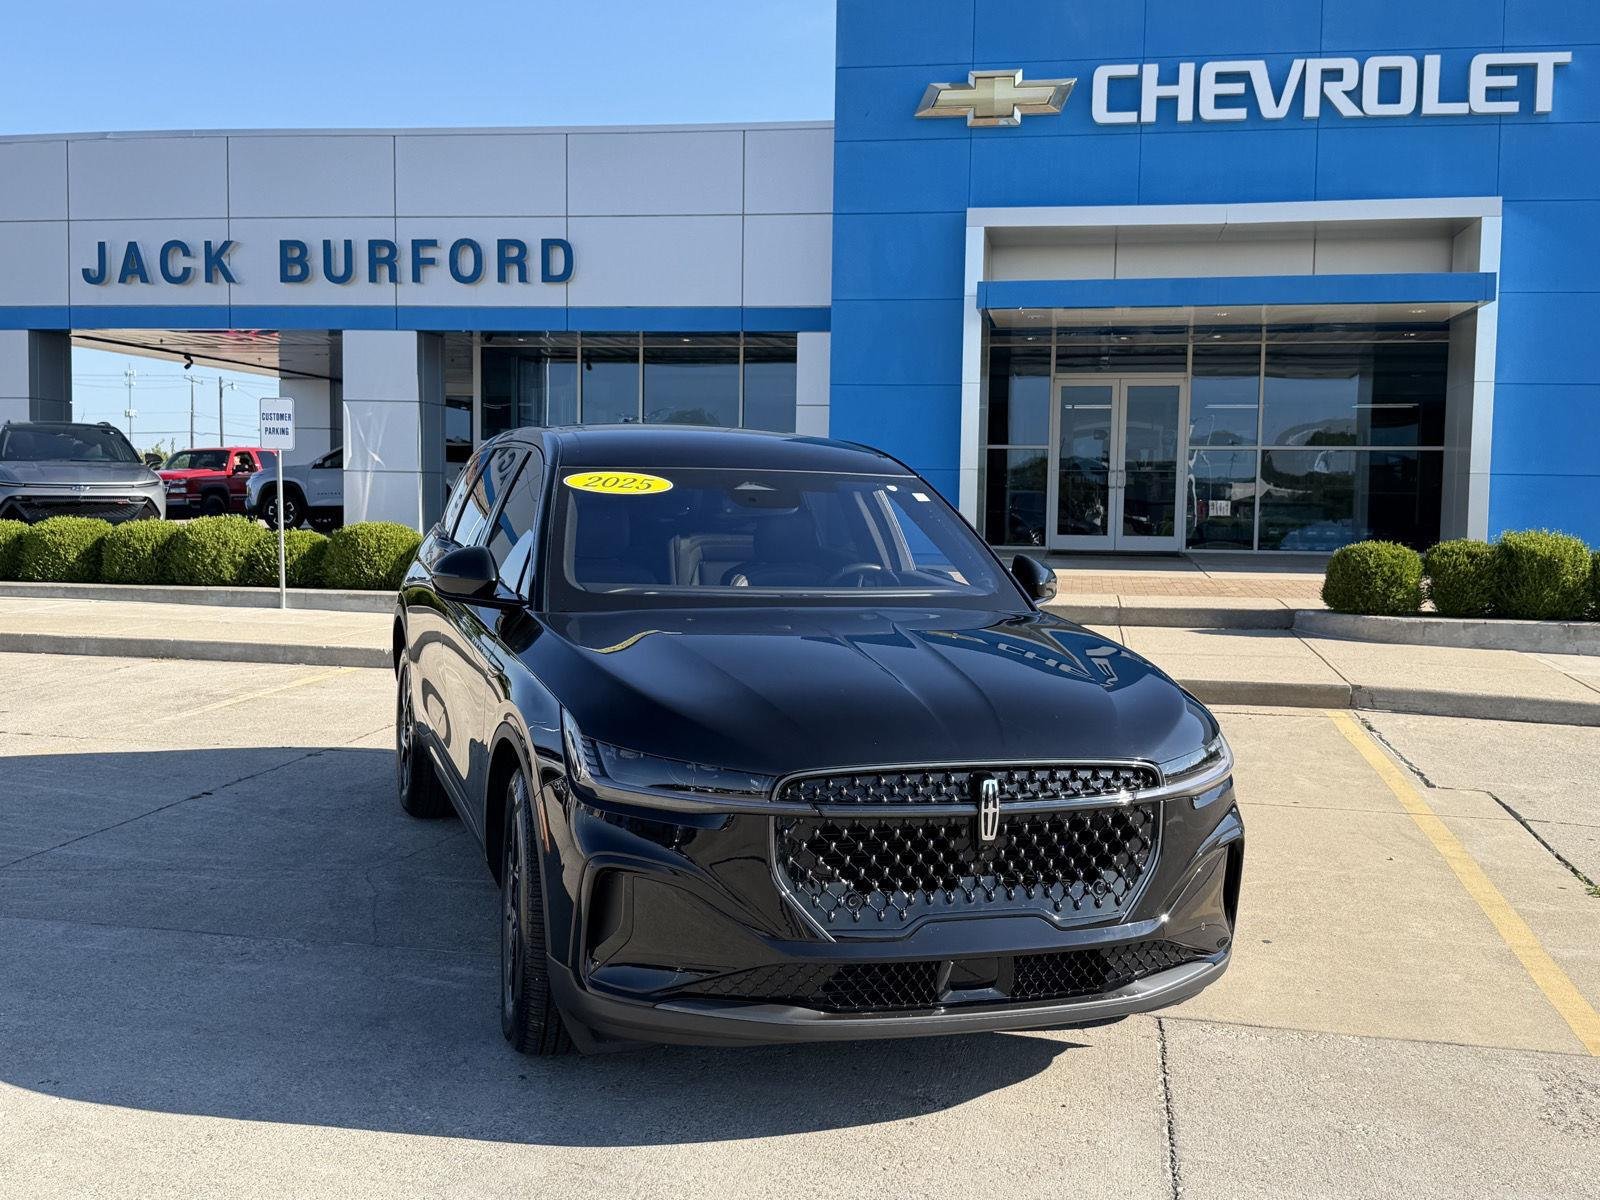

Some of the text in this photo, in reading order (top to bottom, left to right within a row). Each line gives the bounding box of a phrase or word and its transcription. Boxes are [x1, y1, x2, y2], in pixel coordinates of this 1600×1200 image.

[1092, 51, 1573, 125] CHEVROLET
[82, 238, 574, 284] JACK BURFORD
[261, 412, 292, 421] CUSTOMER
[264, 426, 290, 436] PARKING
[583, 475, 655, 491] 2025
